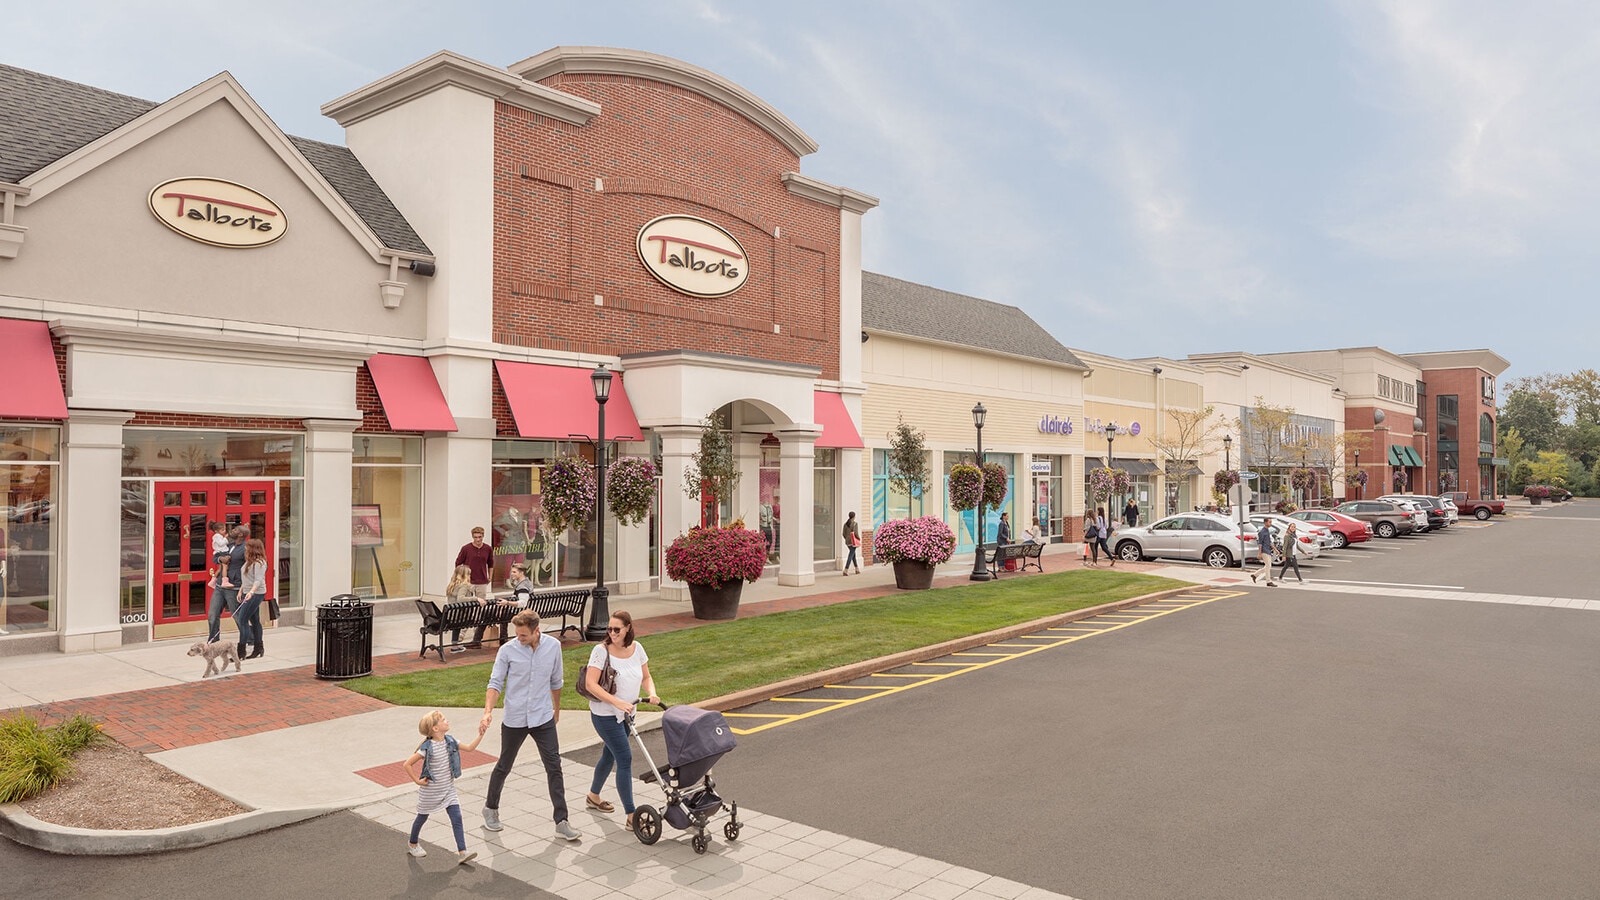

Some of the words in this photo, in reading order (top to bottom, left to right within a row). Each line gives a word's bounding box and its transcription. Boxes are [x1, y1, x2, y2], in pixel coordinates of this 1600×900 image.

[162, 192, 278, 232] Talbots
[647, 235, 743, 279] Talbots
[1039, 414, 1073, 435] claire's
[1031, 463, 1050, 471] claire's
[121, 613, 147, 624] 1000
